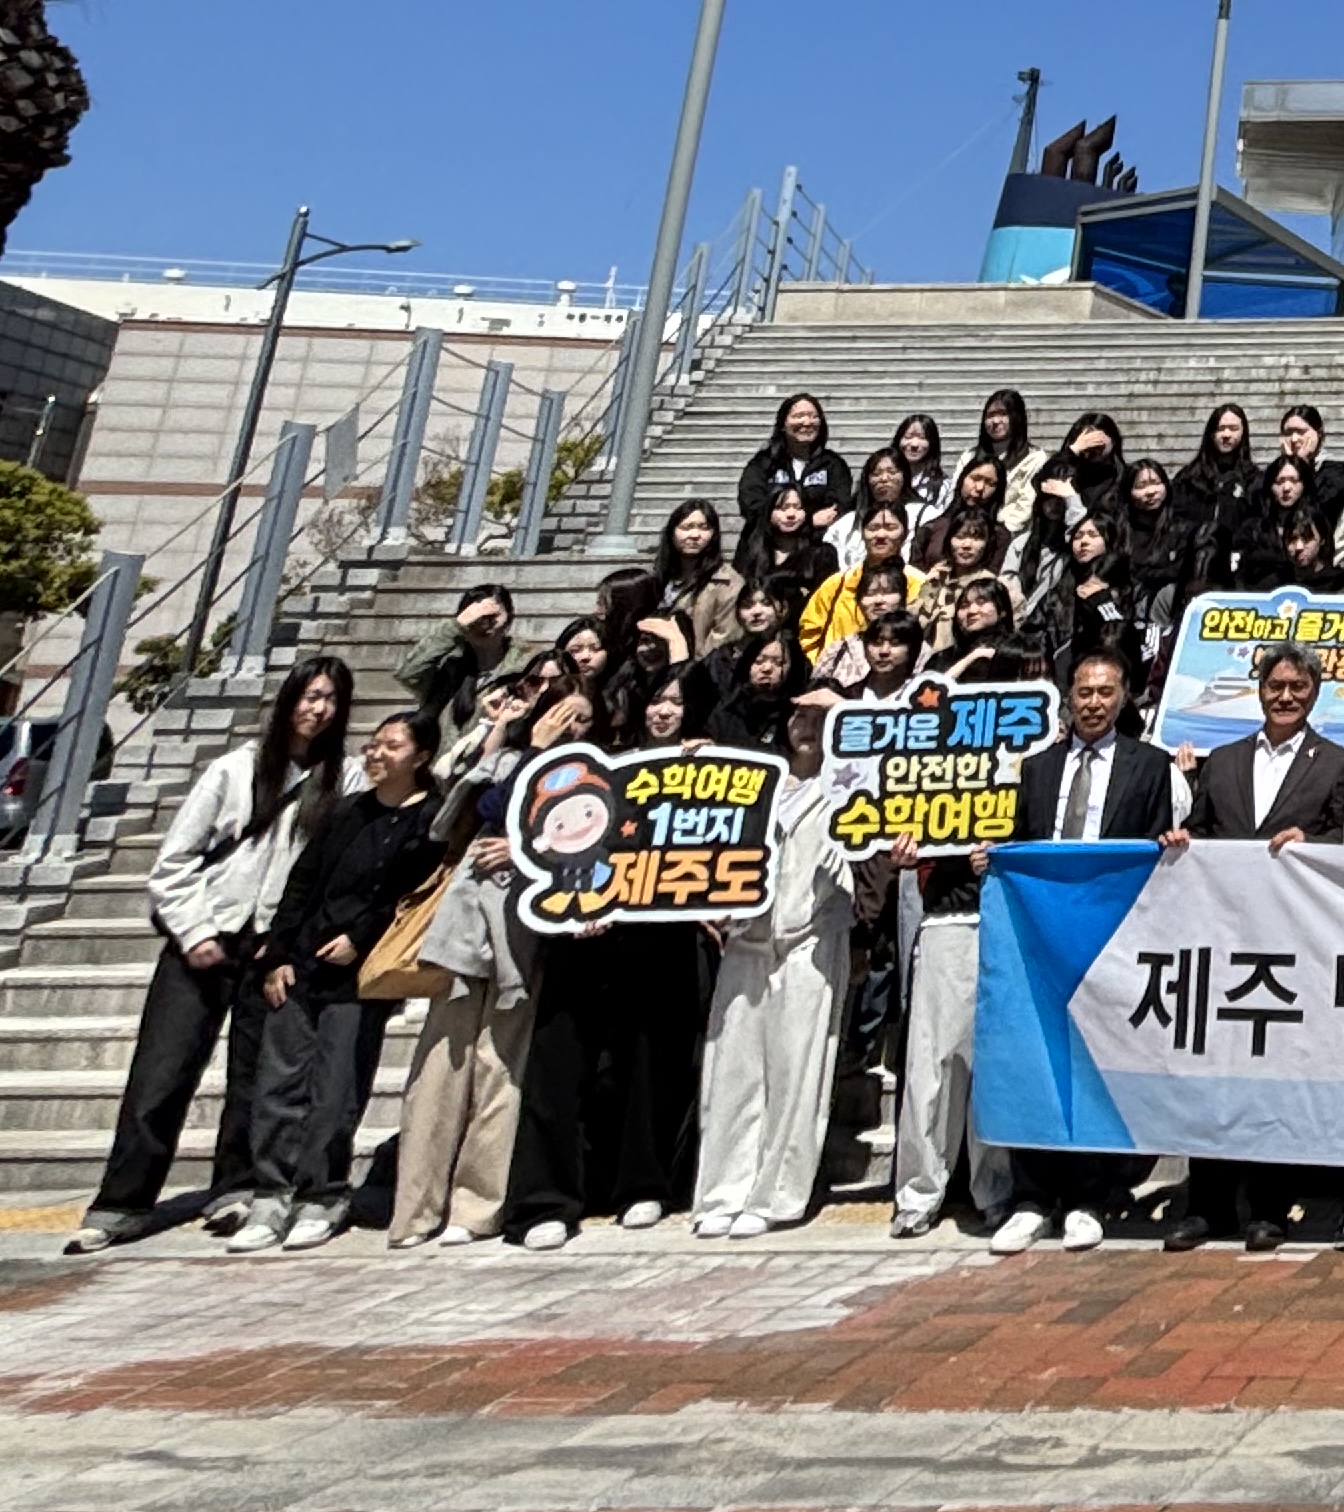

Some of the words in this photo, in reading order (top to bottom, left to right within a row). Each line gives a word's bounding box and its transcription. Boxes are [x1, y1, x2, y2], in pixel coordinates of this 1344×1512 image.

[1201, 609, 1290, 640] 안전하고
[838, 712, 941, 752] 즐거운
[946, 696, 1044, 748] 제주
[624, 762, 768, 806] 수학여행
[886, 752, 993, 793] 안전한
[646, 801, 746, 846] 1번지
[835, 788, 1019, 846] 수학여행
[600, 849, 765, 906] 제주도
[1128, 946, 1304, 1058] 제주
